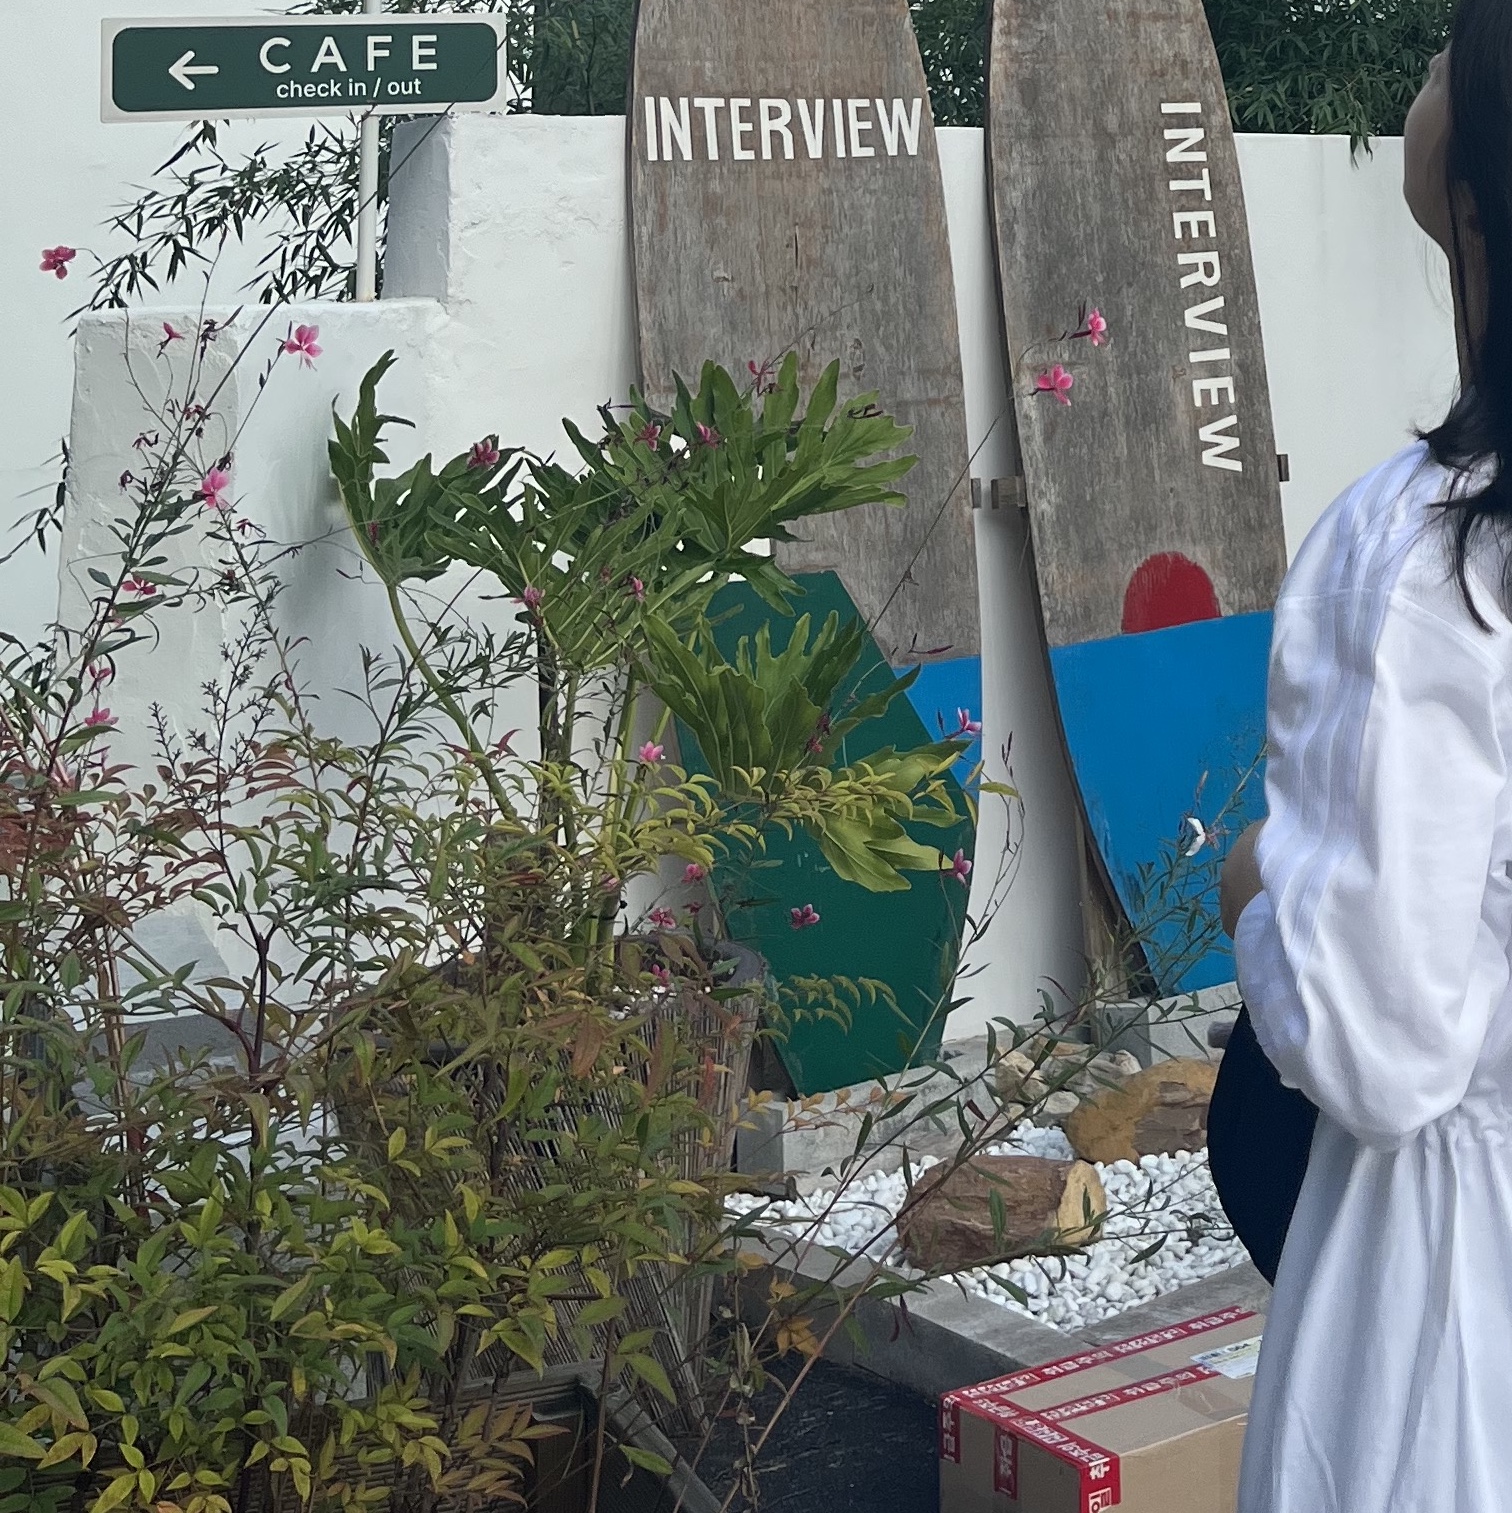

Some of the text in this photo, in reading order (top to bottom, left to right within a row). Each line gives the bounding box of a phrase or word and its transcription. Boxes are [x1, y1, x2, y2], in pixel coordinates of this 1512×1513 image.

[259, 34, 438, 73] CAFE
[275, 80, 342, 99] check
[348, 79, 367, 98] in
[387, 77, 421, 96] out
[645, 95, 922, 161] INTERVIEW
[1159, 102, 1243, 473] INTERVIEW
